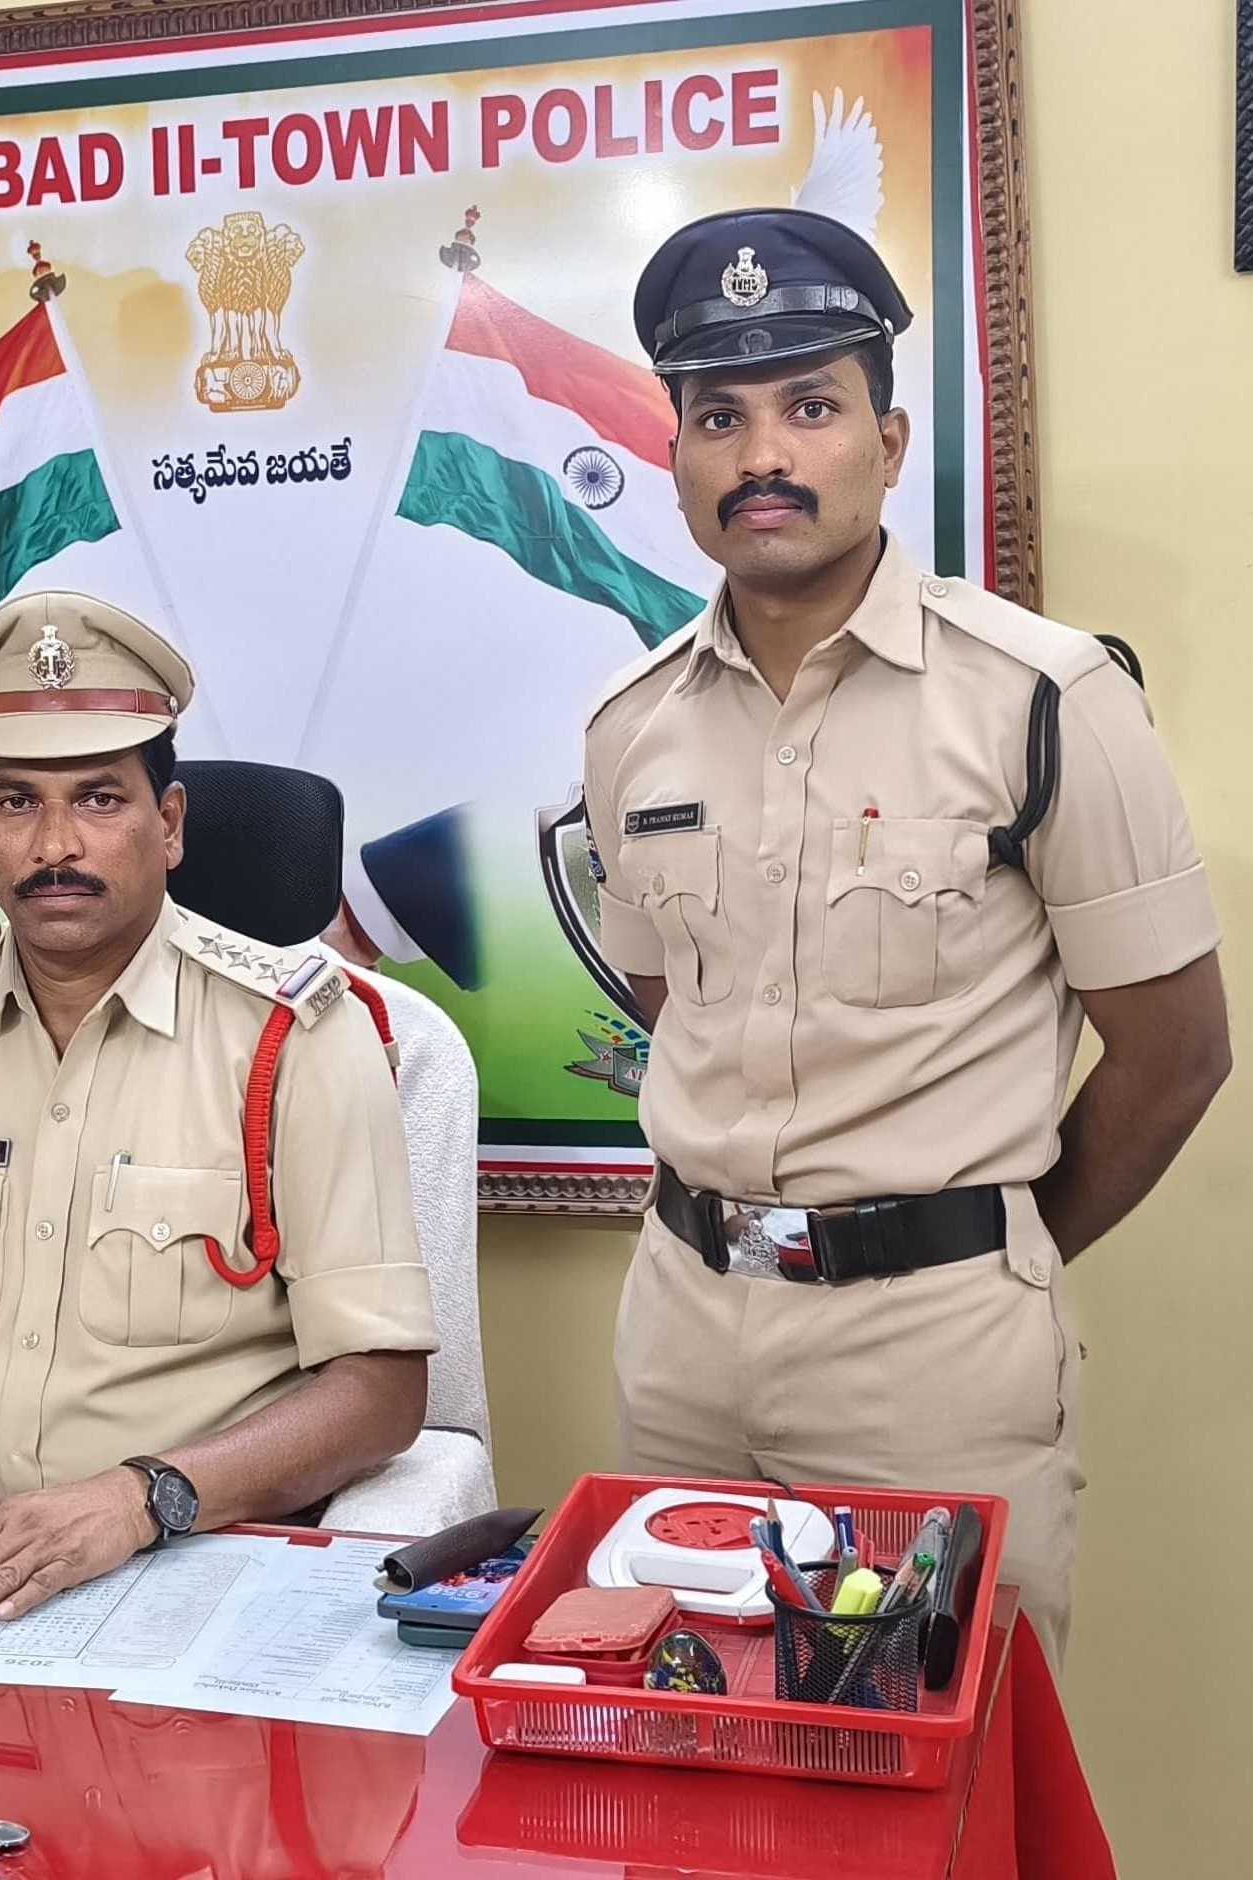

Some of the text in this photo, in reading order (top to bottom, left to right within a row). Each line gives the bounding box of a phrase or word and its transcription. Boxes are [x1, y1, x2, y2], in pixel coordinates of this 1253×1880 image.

[151, 100, 449, 194] II-TOWN
[481, 69, 780, 166] POLICE
[152, 436, 352, 504] సత్యమేవ జయతే
[4, 1659, 55, 1667] 2026
